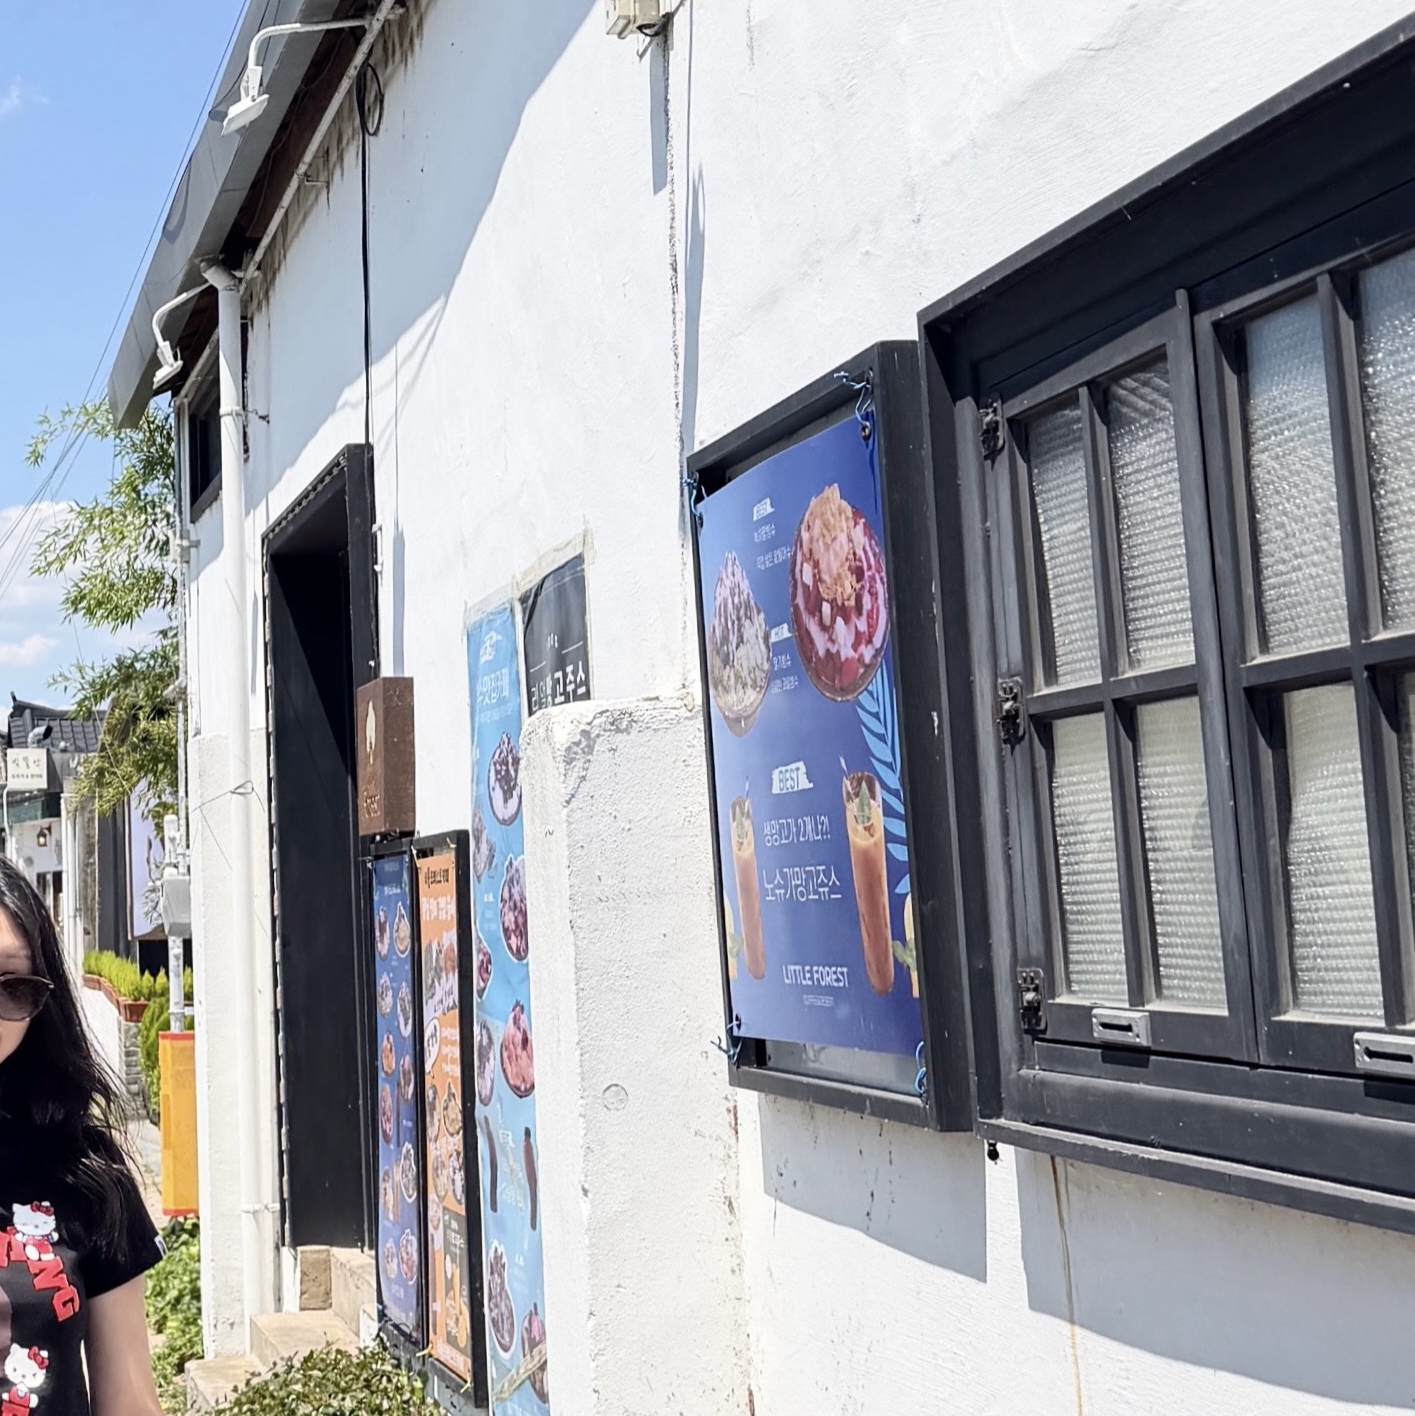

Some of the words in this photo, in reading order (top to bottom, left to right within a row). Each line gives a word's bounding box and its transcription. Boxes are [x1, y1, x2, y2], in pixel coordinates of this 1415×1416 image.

[778, 766, 801, 792] BEST
[764, 818, 797, 847] 생망고가
[763, 865, 842, 902] 노슈가망고쥬스
[782, 965, 813, 986] LITTLE
[813, 966, 849, 988] FOREST
